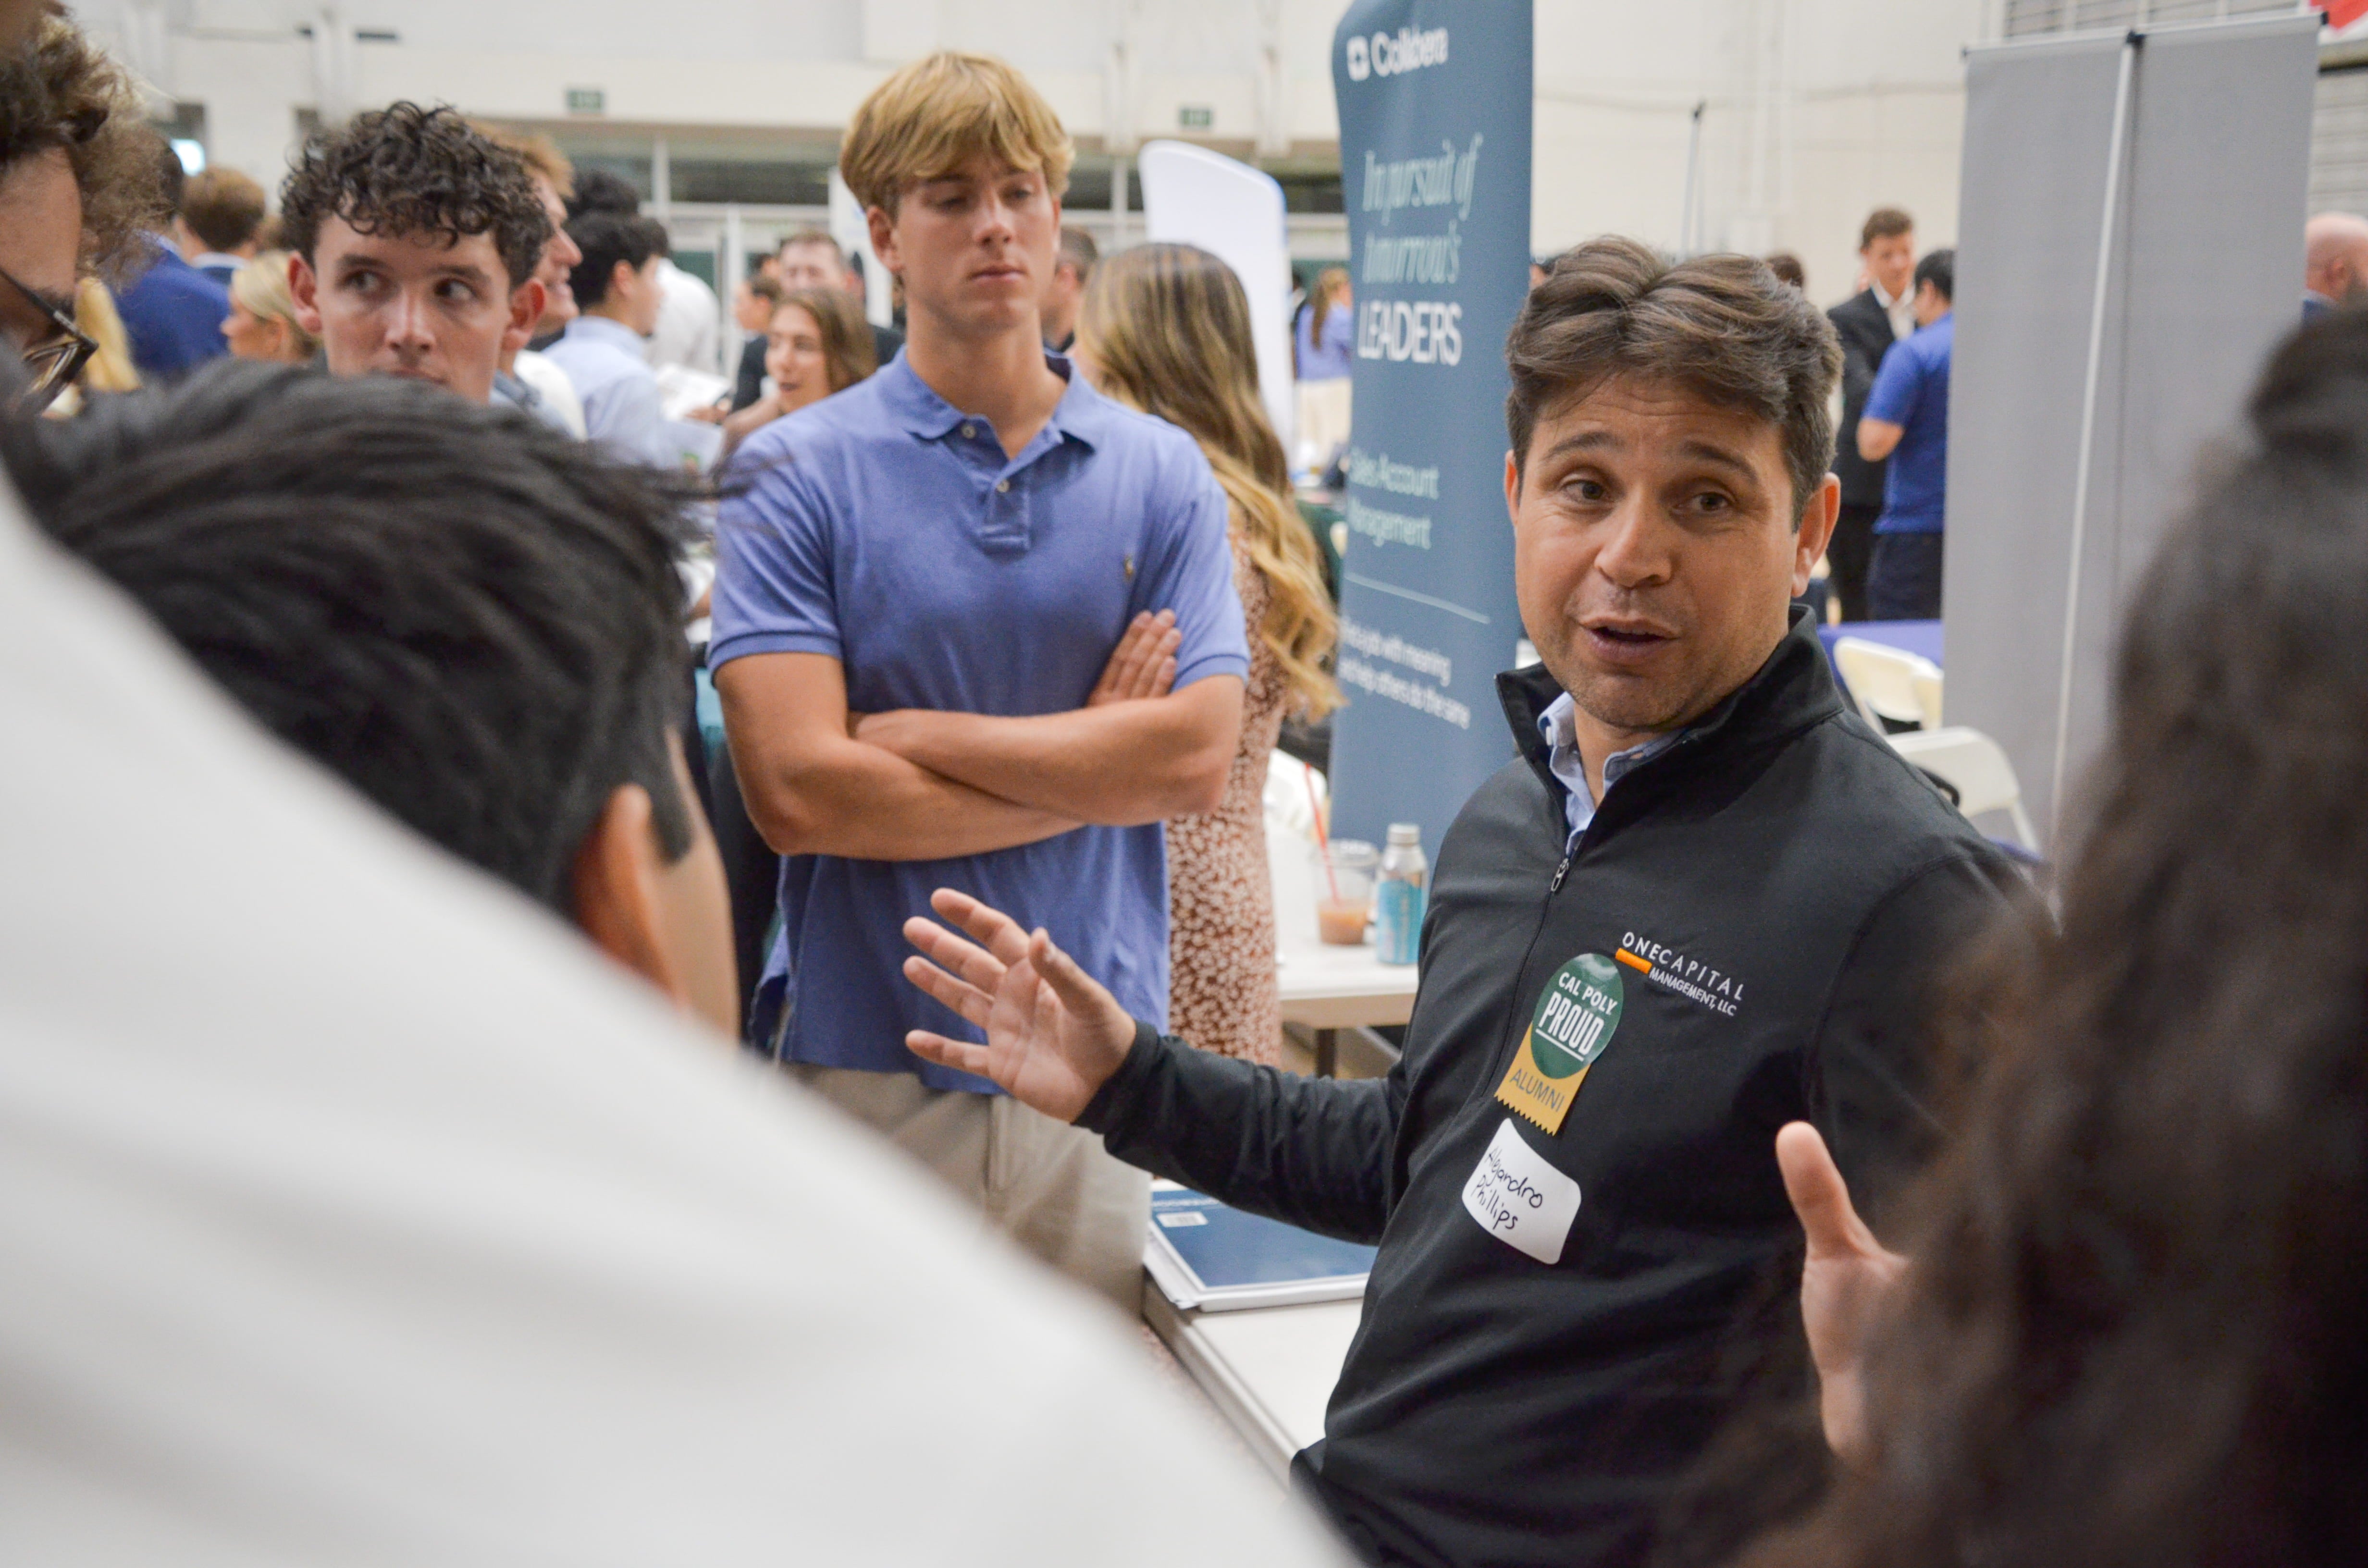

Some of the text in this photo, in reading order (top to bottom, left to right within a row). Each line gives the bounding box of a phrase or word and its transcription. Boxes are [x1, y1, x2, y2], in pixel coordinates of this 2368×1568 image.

[1381, 138, 1455, 226] pursuit
[1454, 132, 1483, 221] of
[1358, 300, 1463, 367] LEADERS
[1377, 453, 1440, 500] Account
[1558, 972, 1618, 1015] CAL POLY
[1649, 967, 1737, 1017] MANAGEMENT, LLC
[1538, 991, 1604, 1055] PROUD
[1510, 1068, 1565, 1113] ALUMNI
[1471, 1174, 1518, 1230] Phillips
[1485, 1146, 1543, 1208] Alejandro
